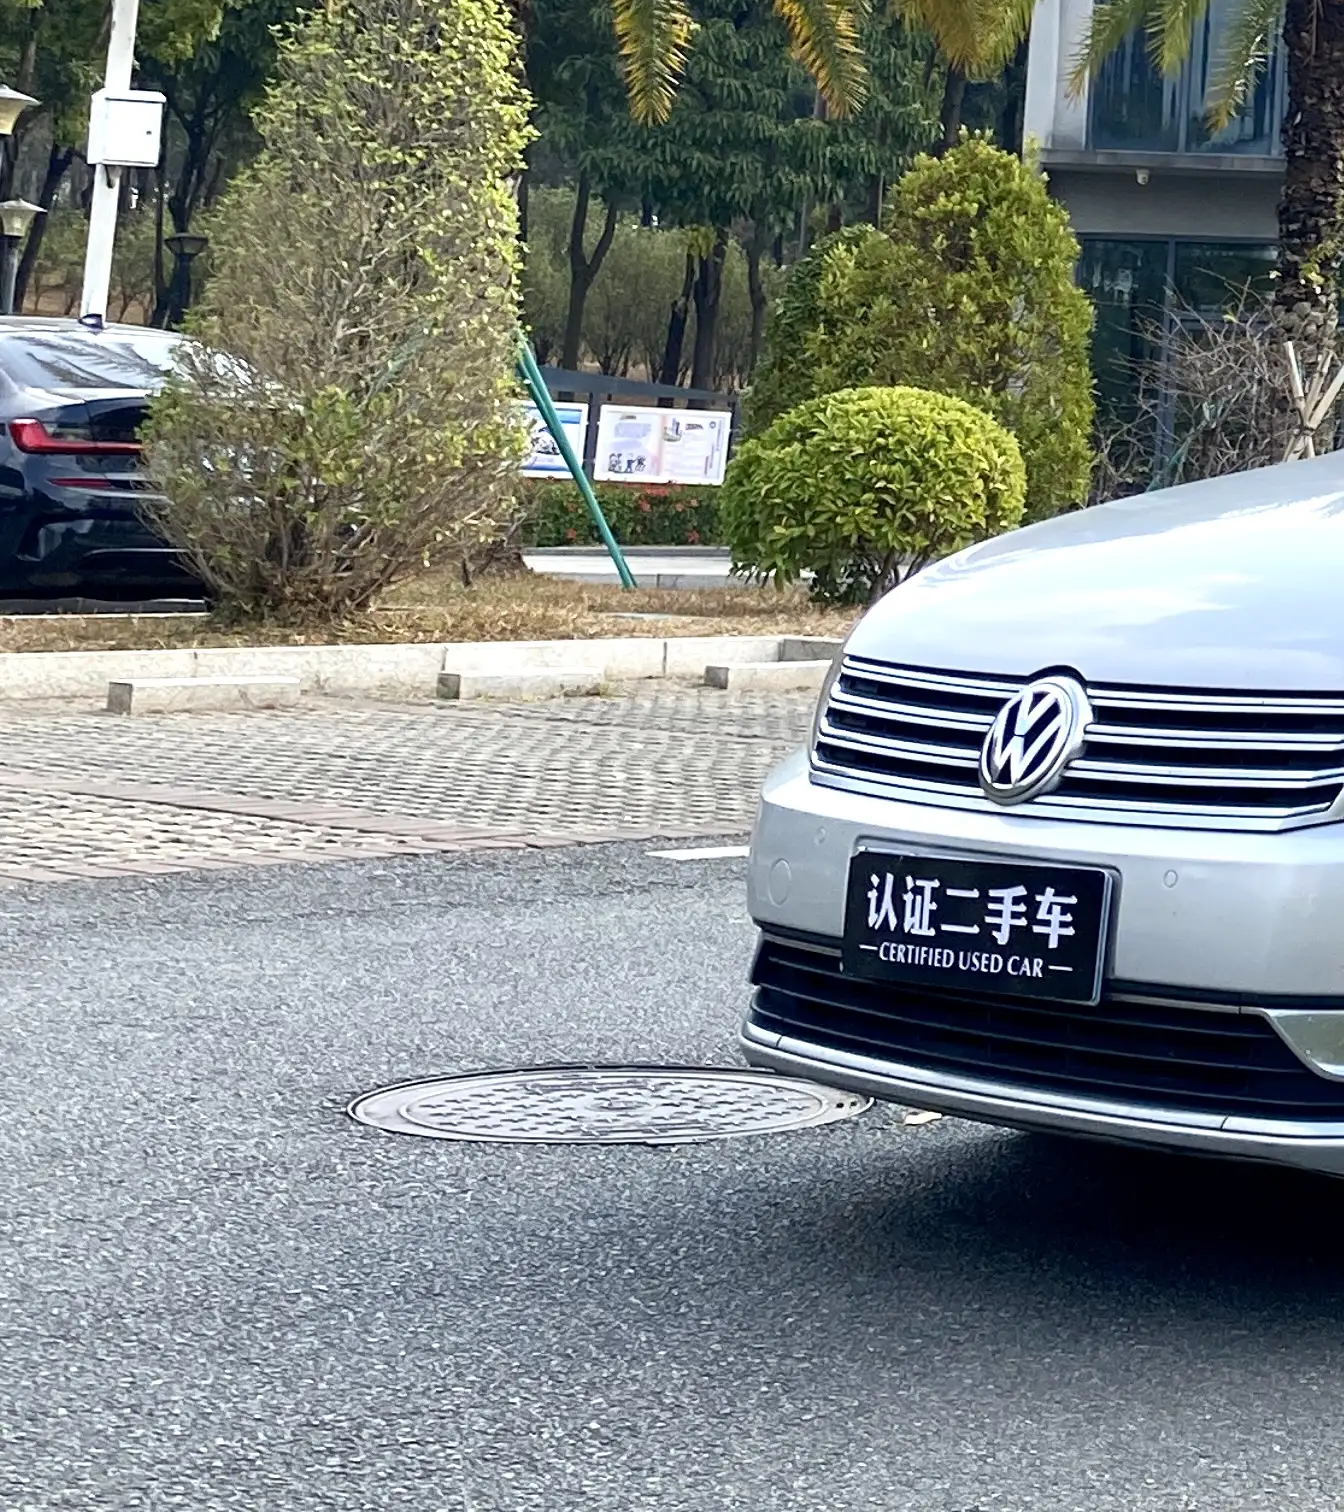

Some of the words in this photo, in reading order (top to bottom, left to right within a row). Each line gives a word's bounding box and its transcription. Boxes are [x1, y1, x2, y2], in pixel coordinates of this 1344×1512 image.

[867, 872, 1078, 949] 认证二手车
[878, 941, 955, 969] CERTIFIED
[958, 950, 1004, 974] USED
[1007, 955, 1044, 978] CAR
